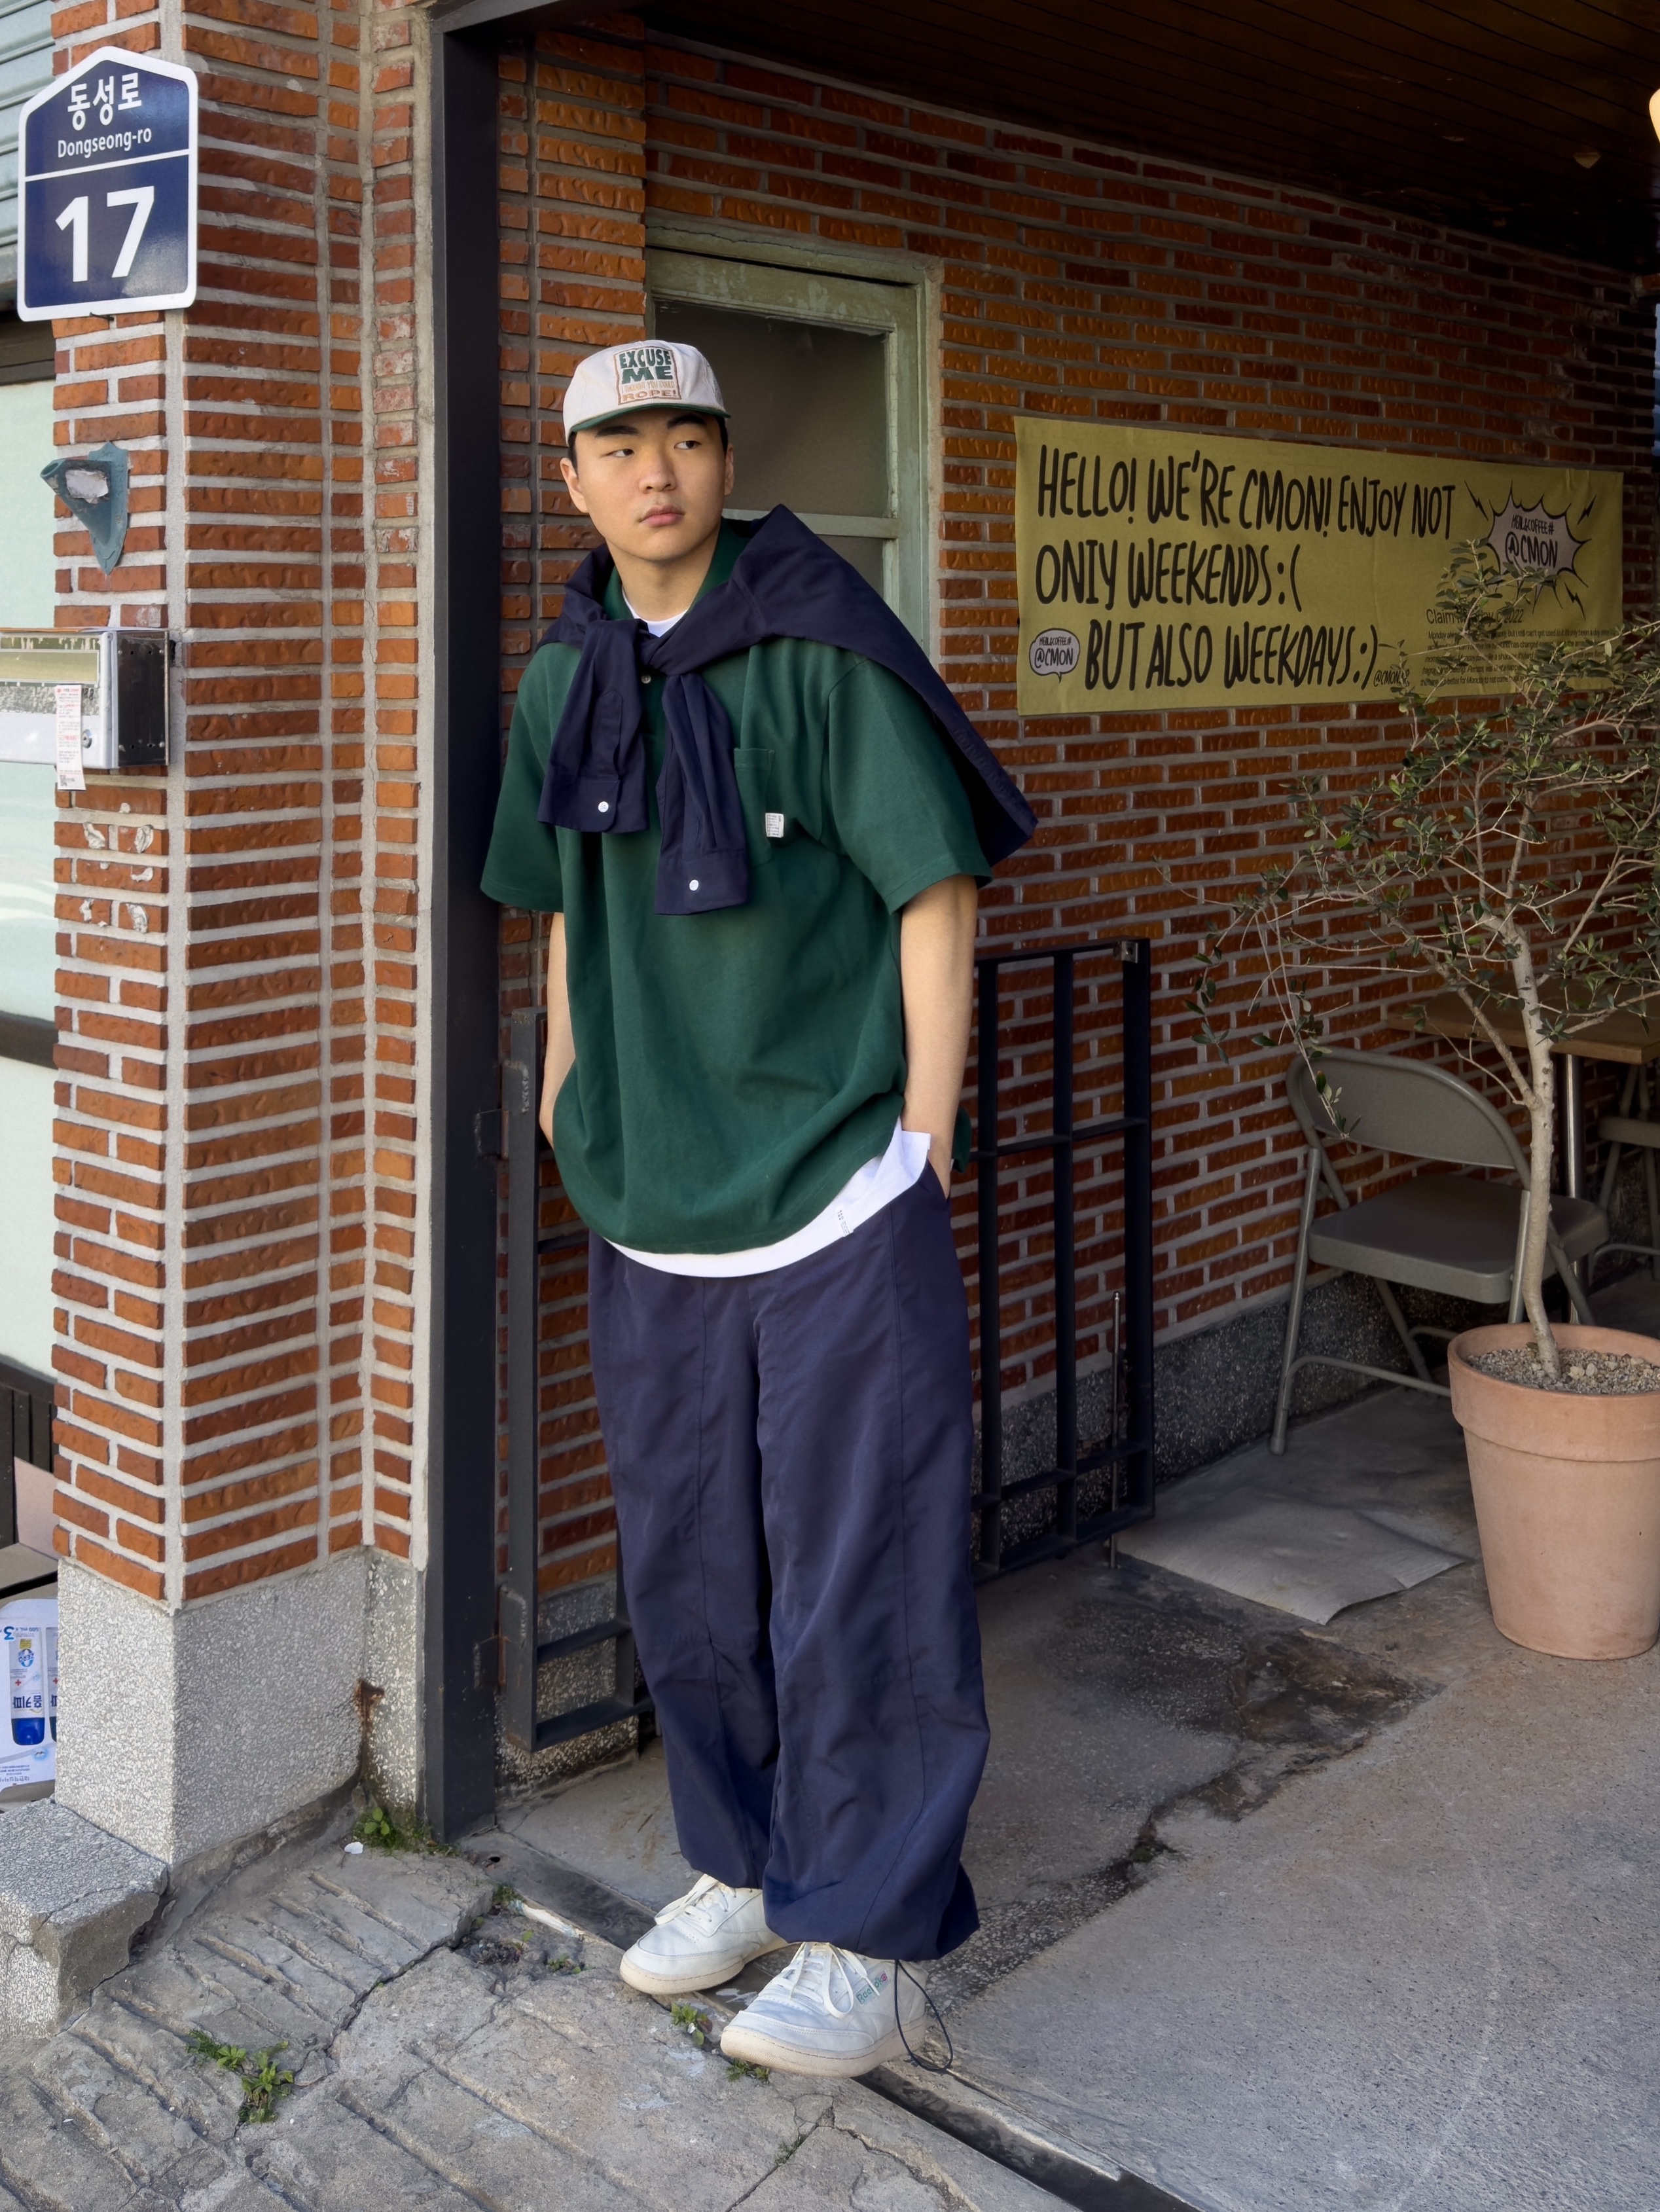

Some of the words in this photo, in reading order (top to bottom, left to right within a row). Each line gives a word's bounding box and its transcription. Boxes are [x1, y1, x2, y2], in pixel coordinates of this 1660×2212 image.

[67, 72, 143, 131] 동성로
[58, 128, 152, 158] Dongseong-ro
[55, 185, 154, 283] 17
[619, 348, 672, 369] EXCUSE
[621, 365, 673, 384] ME
[622, 390, 677, 401] ROPE!
[624, 381, 645, 392] THOUGHT
[647, 380, 659, 389] YOU
[1038, 444, 1137, 524] HELLO!
[1147, 449, 1236, 529] WE'RE
[1239, 469, 1331, 538] CMON!
[1338, 475, 1407, 538] ENJOY
[1411, 484, 1455, 539] NOT
[1505, 531, 1558, 568] @CMON
[1426, 608, 1454, 624] Claim
[1034, 647, 1074, 668] @CMON
[1085, 619, 1146, 691] BUT
[1145, 622, 1212, 690] ALSO
[3, 1626, 14, 1640] 3
[12, 1695, 42, 1709] 홈키파
